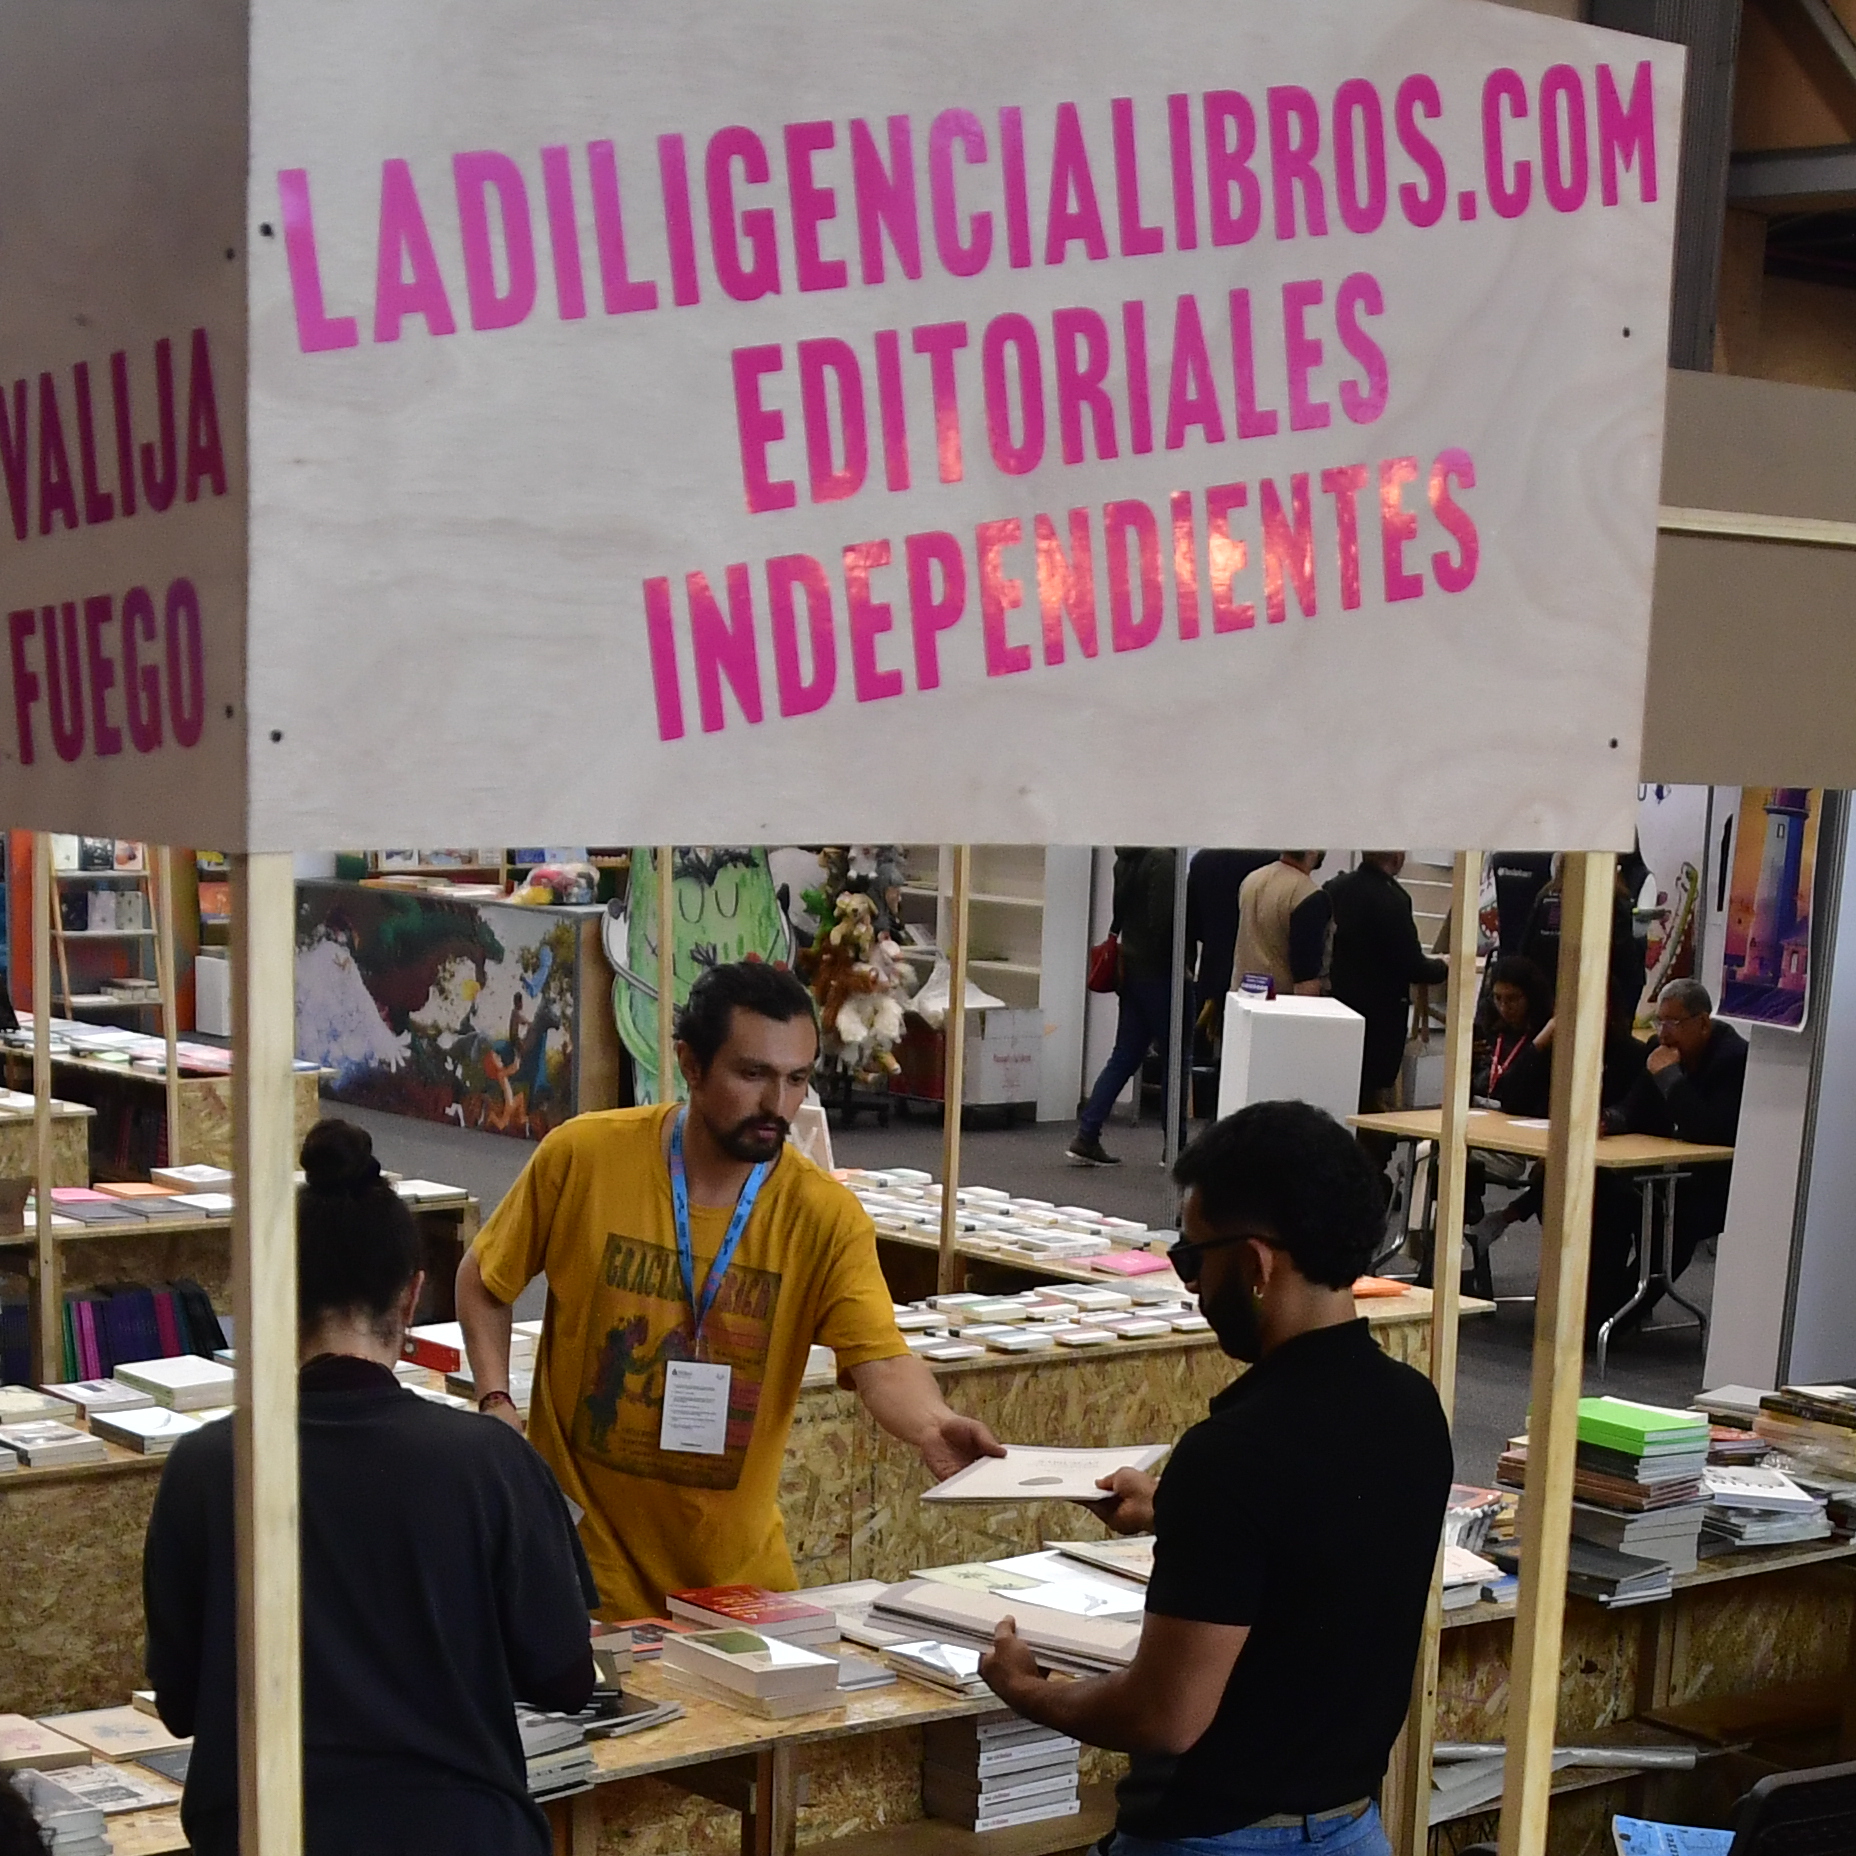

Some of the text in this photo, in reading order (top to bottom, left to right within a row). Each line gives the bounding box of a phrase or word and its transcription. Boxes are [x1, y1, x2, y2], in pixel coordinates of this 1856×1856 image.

[276, 58, 1660, 355] LADILIGENCIALIBROS.COM
[730, 271, 1391, 516] EDITORIALES
[8, 576, 206, 765] FUEGO
[642, 447, 1481, 742] INDEPENDIENTES
